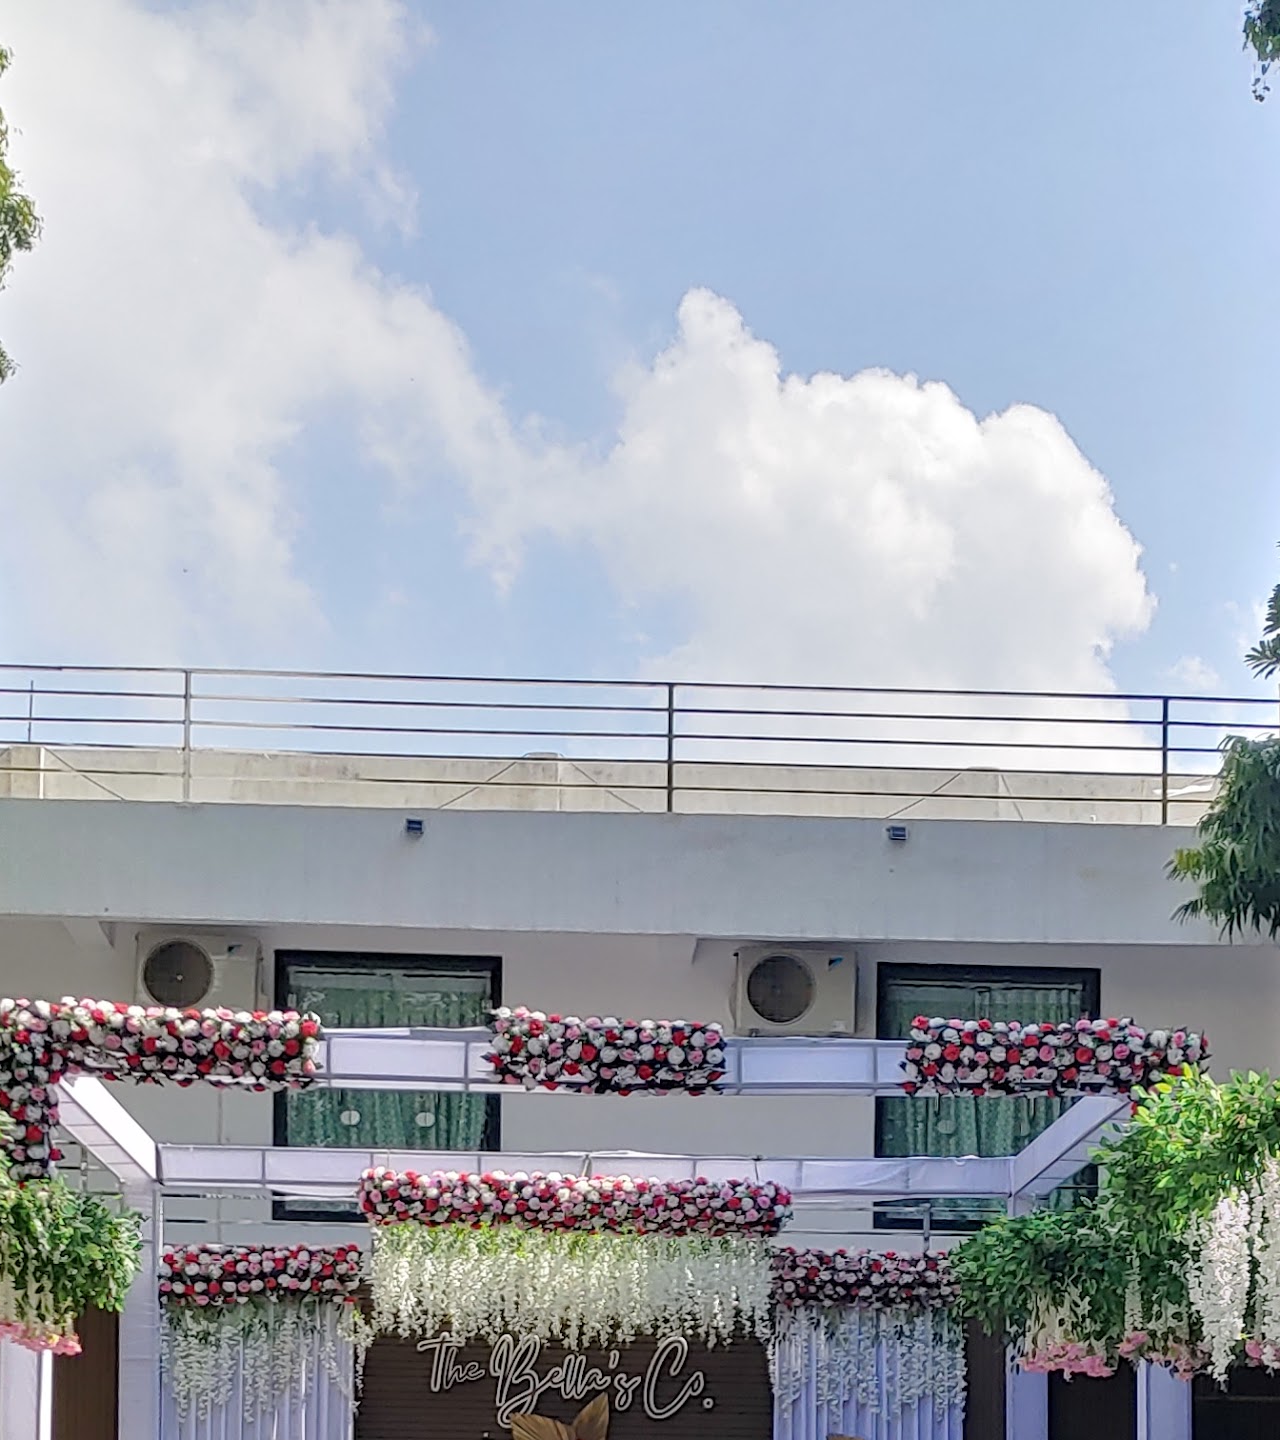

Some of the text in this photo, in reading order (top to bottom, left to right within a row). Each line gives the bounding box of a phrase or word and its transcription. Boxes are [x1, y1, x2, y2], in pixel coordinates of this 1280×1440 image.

[417, 1331, 714, 1429] The Bella's Co.
